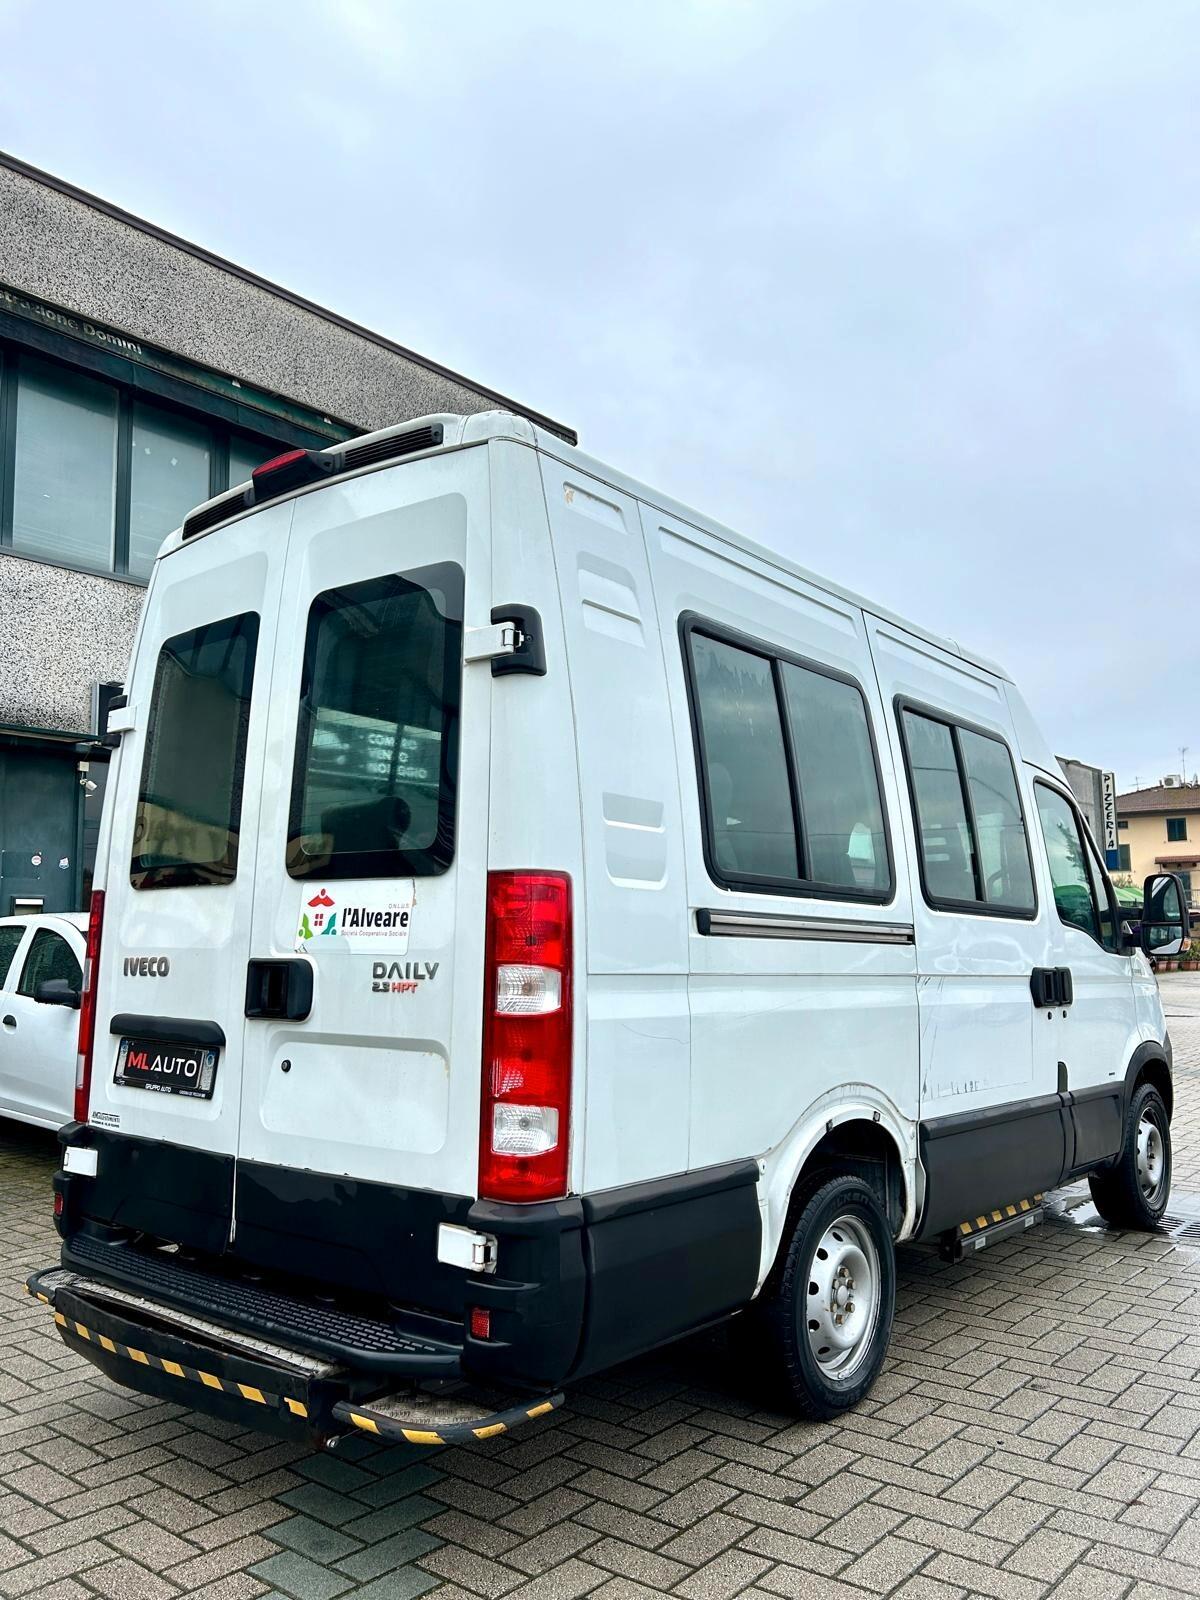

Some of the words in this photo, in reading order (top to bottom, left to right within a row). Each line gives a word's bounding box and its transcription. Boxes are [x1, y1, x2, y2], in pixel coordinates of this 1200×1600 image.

[83, 322, 142, 355] Domini
[1103, 774, 1115, 849] PIZZERIA
[341, 907, 409, 928] l'Alveare
[123, 956, 170, 978] IVECO
[372, 961, 440, 980] DAILY
[391, 981, 419, 994] HPT
[127, 1051, 149, 1070] ML
[150, 1054, 198, 1078] AUTO
[145, 1083, 160, 1091] GRUPPO
[160, 1085, 172, 1093] AUTO
